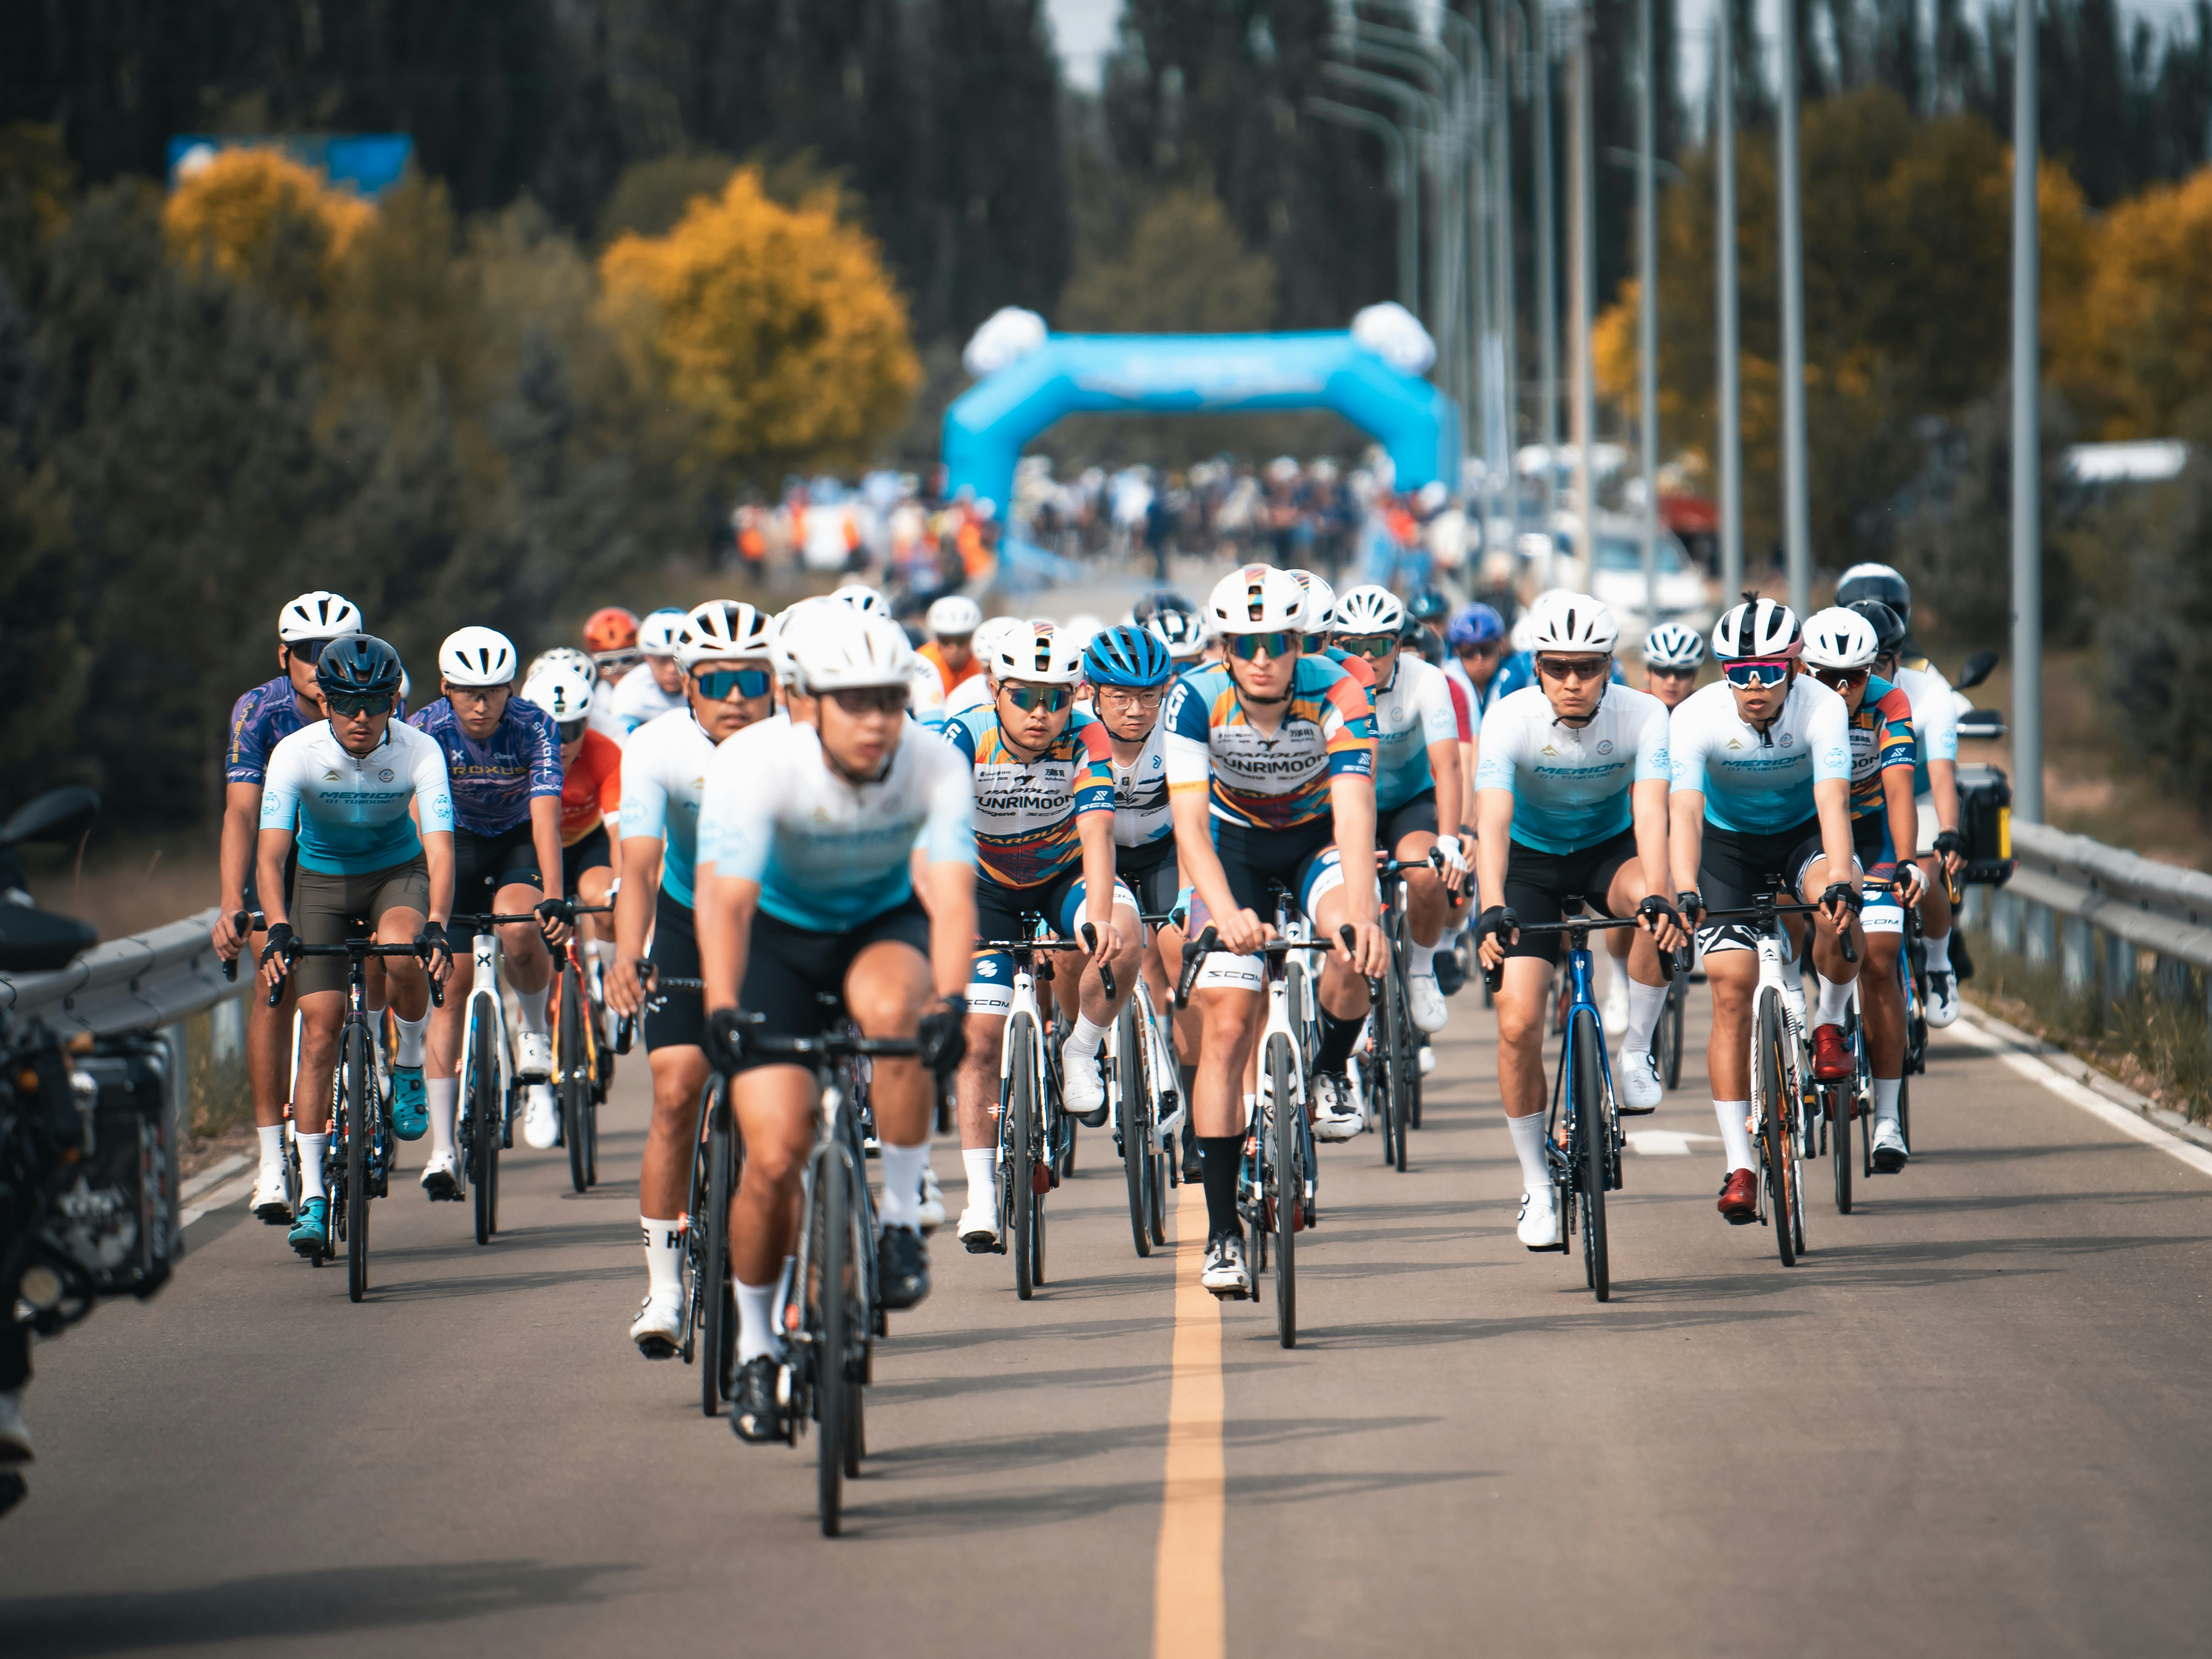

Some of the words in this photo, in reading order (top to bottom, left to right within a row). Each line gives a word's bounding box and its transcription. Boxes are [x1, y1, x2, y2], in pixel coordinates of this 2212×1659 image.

[532, 721, 552, 777] TROXUS
[1721, 753, 1807, 767] MERIDA
[447, 765, 527, 774] ROXUS
[1534, 762, 1626, 775] MERIDA
[976, 817, 1070, 844] PARDUS
